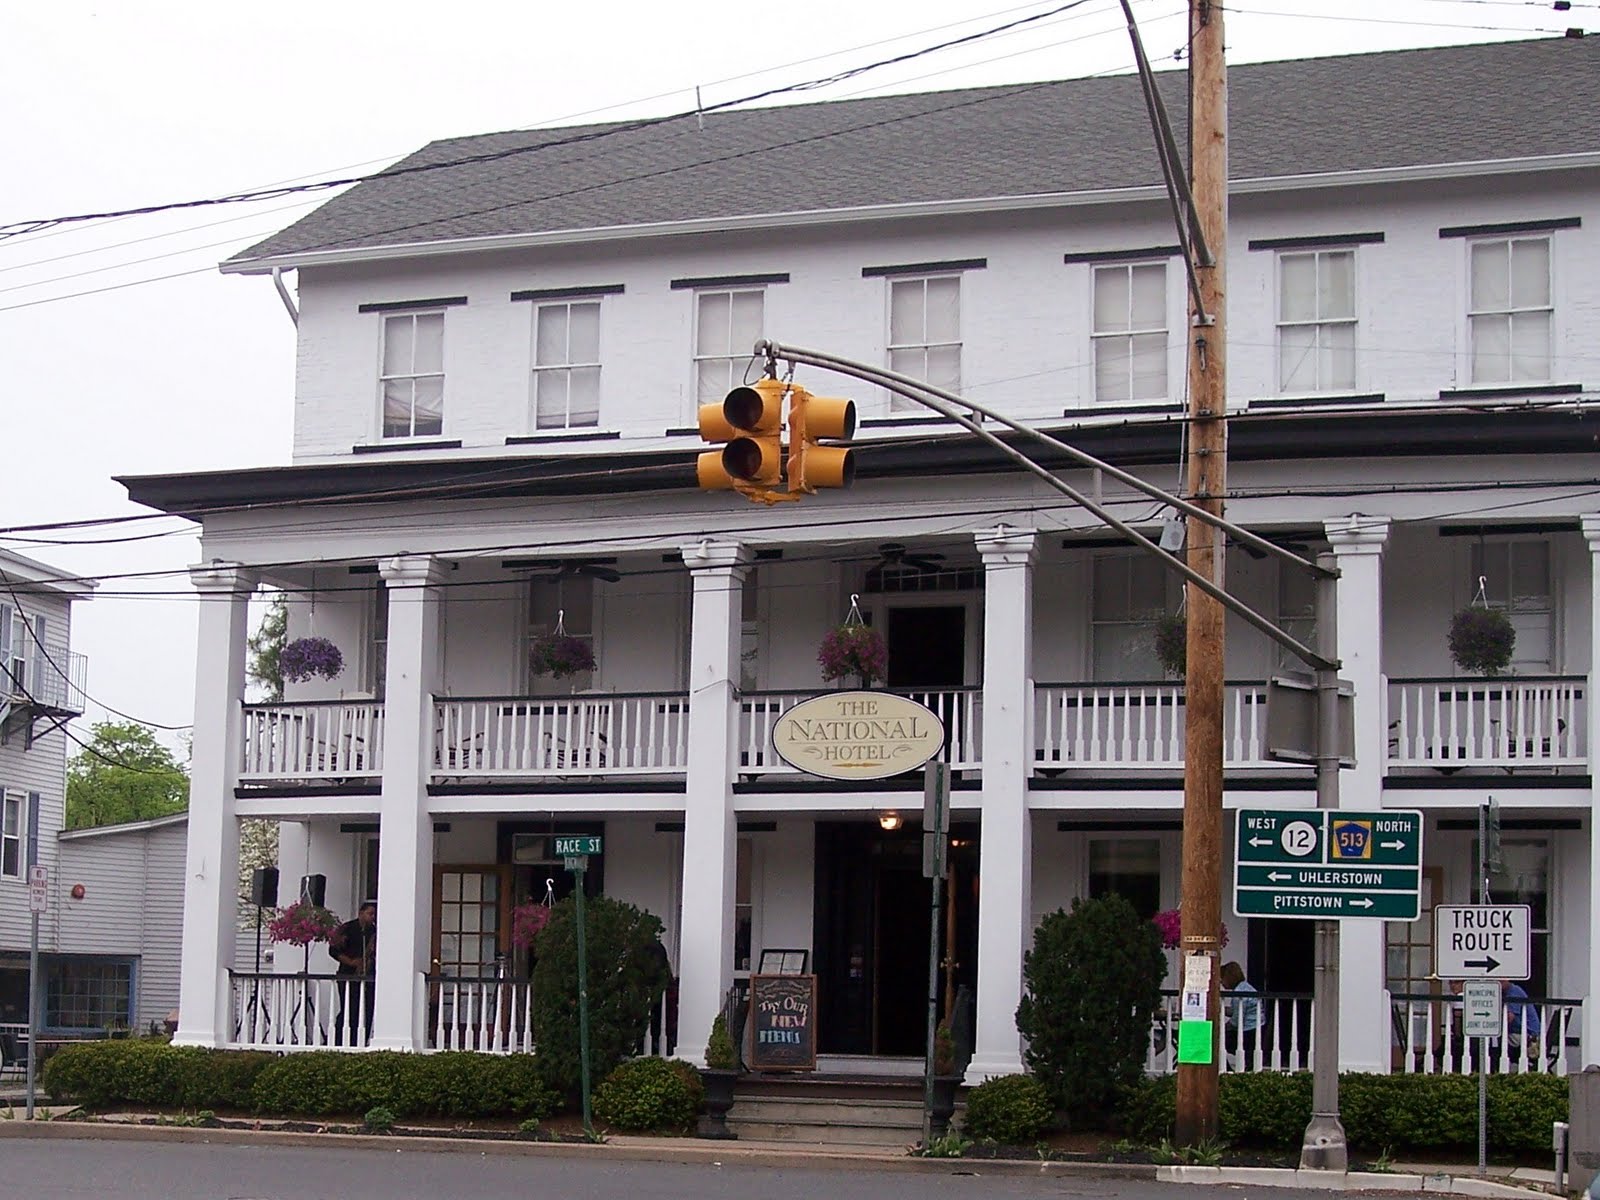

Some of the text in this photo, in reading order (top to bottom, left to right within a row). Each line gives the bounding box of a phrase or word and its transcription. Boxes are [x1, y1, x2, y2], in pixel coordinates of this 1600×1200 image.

[837, 701, 878, 715] THE
[788, 717, 928, 741] NATIONAL
[824, 745, 891, 760] HOTEL
[1247, 818, 1309, 848] WEST 12
[1340, 821, 1411, 847] 513 NORTH
[556, 839, 600, 853] RACE ST
[1299, 872, 1382, 884] UHLERSTOWN
[1274, 895, 1342, 908] PITTSTOWN
[1452, 910, 1513, 928] TRUCK
[1452, 933, 1513, 951] ROUTE
[1468, 989, 1496, 998] MUNICIPAL
[1471, 1000, 1493, 1008] OFFICES
[771, 1015, 807, 1028] NEW
